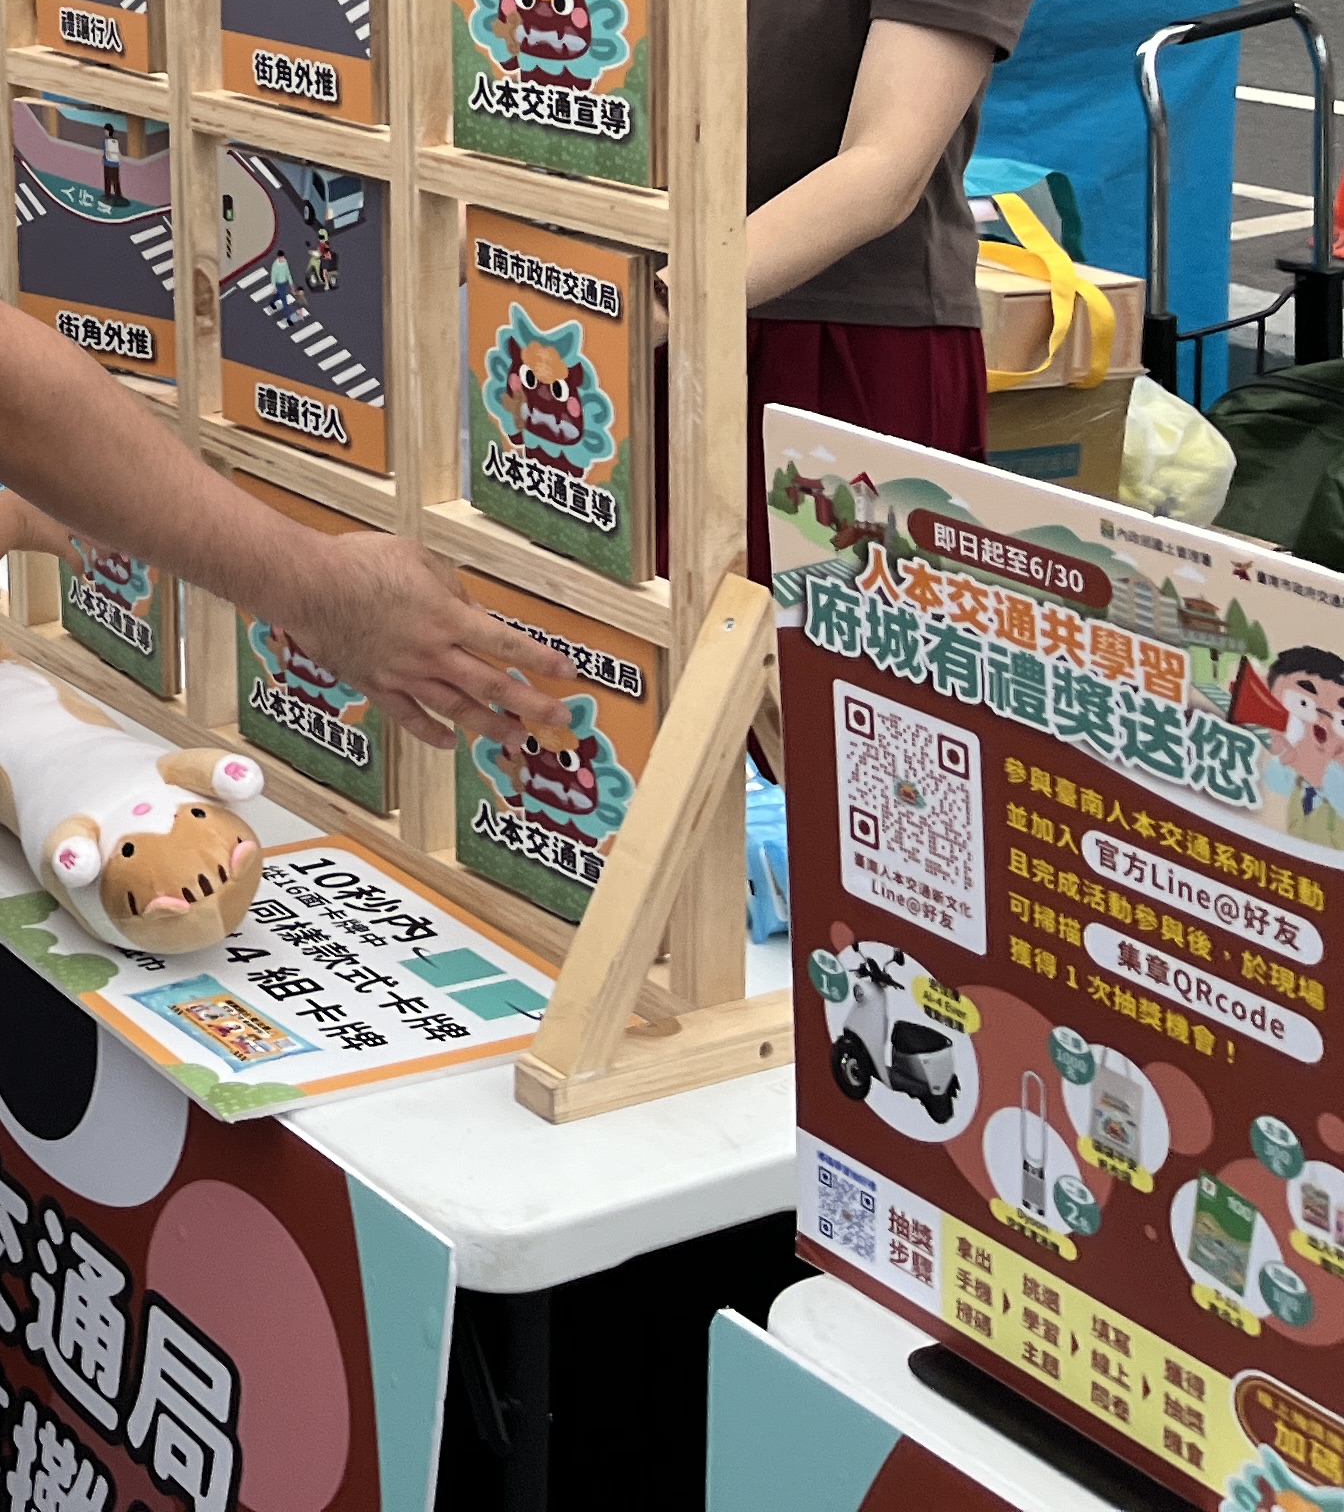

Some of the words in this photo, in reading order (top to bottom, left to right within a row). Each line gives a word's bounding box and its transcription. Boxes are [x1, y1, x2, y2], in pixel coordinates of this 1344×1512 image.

[60, 8, 123, 52] 禮讓行人
[254, 54, 338, 102] 街角外推
[470, 76, 632, 139] 人本交通宣導
[475, 240, 619, 316] 臺南市政府交通局
[58, 312, 152, 357] 街角外推
[257, 385, 347, 444] 禮讓行人
[485, 442, 616, 531] 人本交通宣導
[933, 522, 1085, 593] 即日起至6/30
[69, 577, 151, 654] 人本交通宣導
[860, 547, 1188, 704] 人本交通共學習
[251, 679, 369, 766] 人本交通宣導
[807, 578, 1262, 810] 府城有禮獎送您
[473, 801, 603, 886] 人本交通宣
[1004, 757, 1325, 912] 參與臺南人本交通系列活動
[289, 857, 437, 941] 10秒內
[872, 879, 954, 930] Line@好友
[1006, 803, 1079, 855] 並加入
[1095, 838, 1300, 952] 官方Line@好友
[1008, 892, 1081, 946] 可掃描
[1117, 941, 1287, 1040] 集章QRcode
